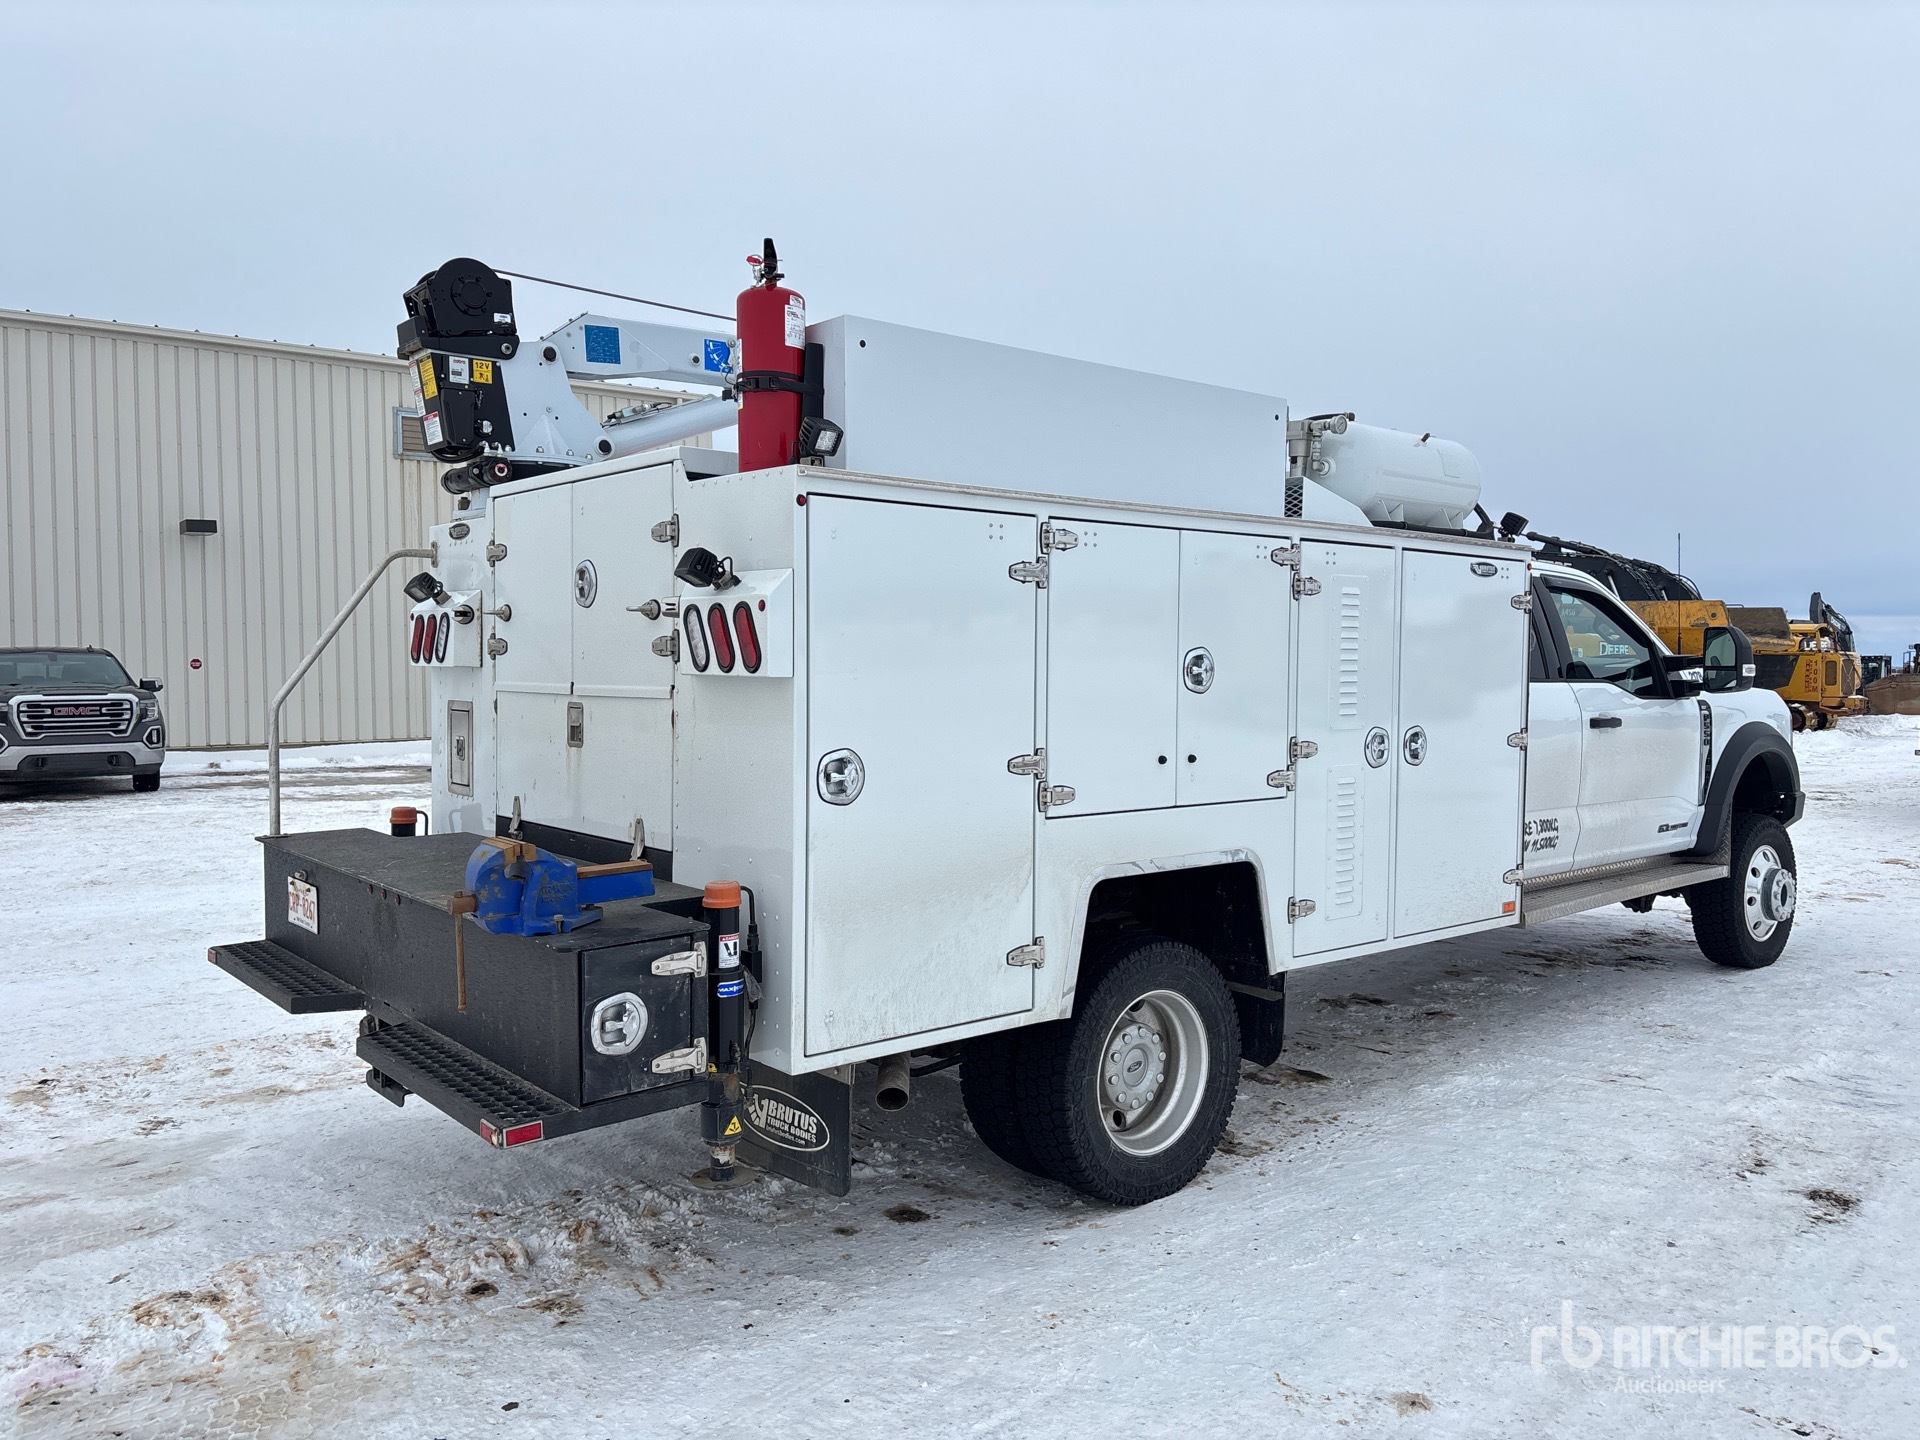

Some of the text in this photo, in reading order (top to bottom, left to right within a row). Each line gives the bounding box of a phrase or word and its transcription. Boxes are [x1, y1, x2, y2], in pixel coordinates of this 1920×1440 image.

[1599, 641, 1629, 655] DEERE
[53, 706, 100, 716] GMC
[767, 1099, 817, 1134] BRUTUS
[766, 1115, 816, 1143] TRUCK BODIES
